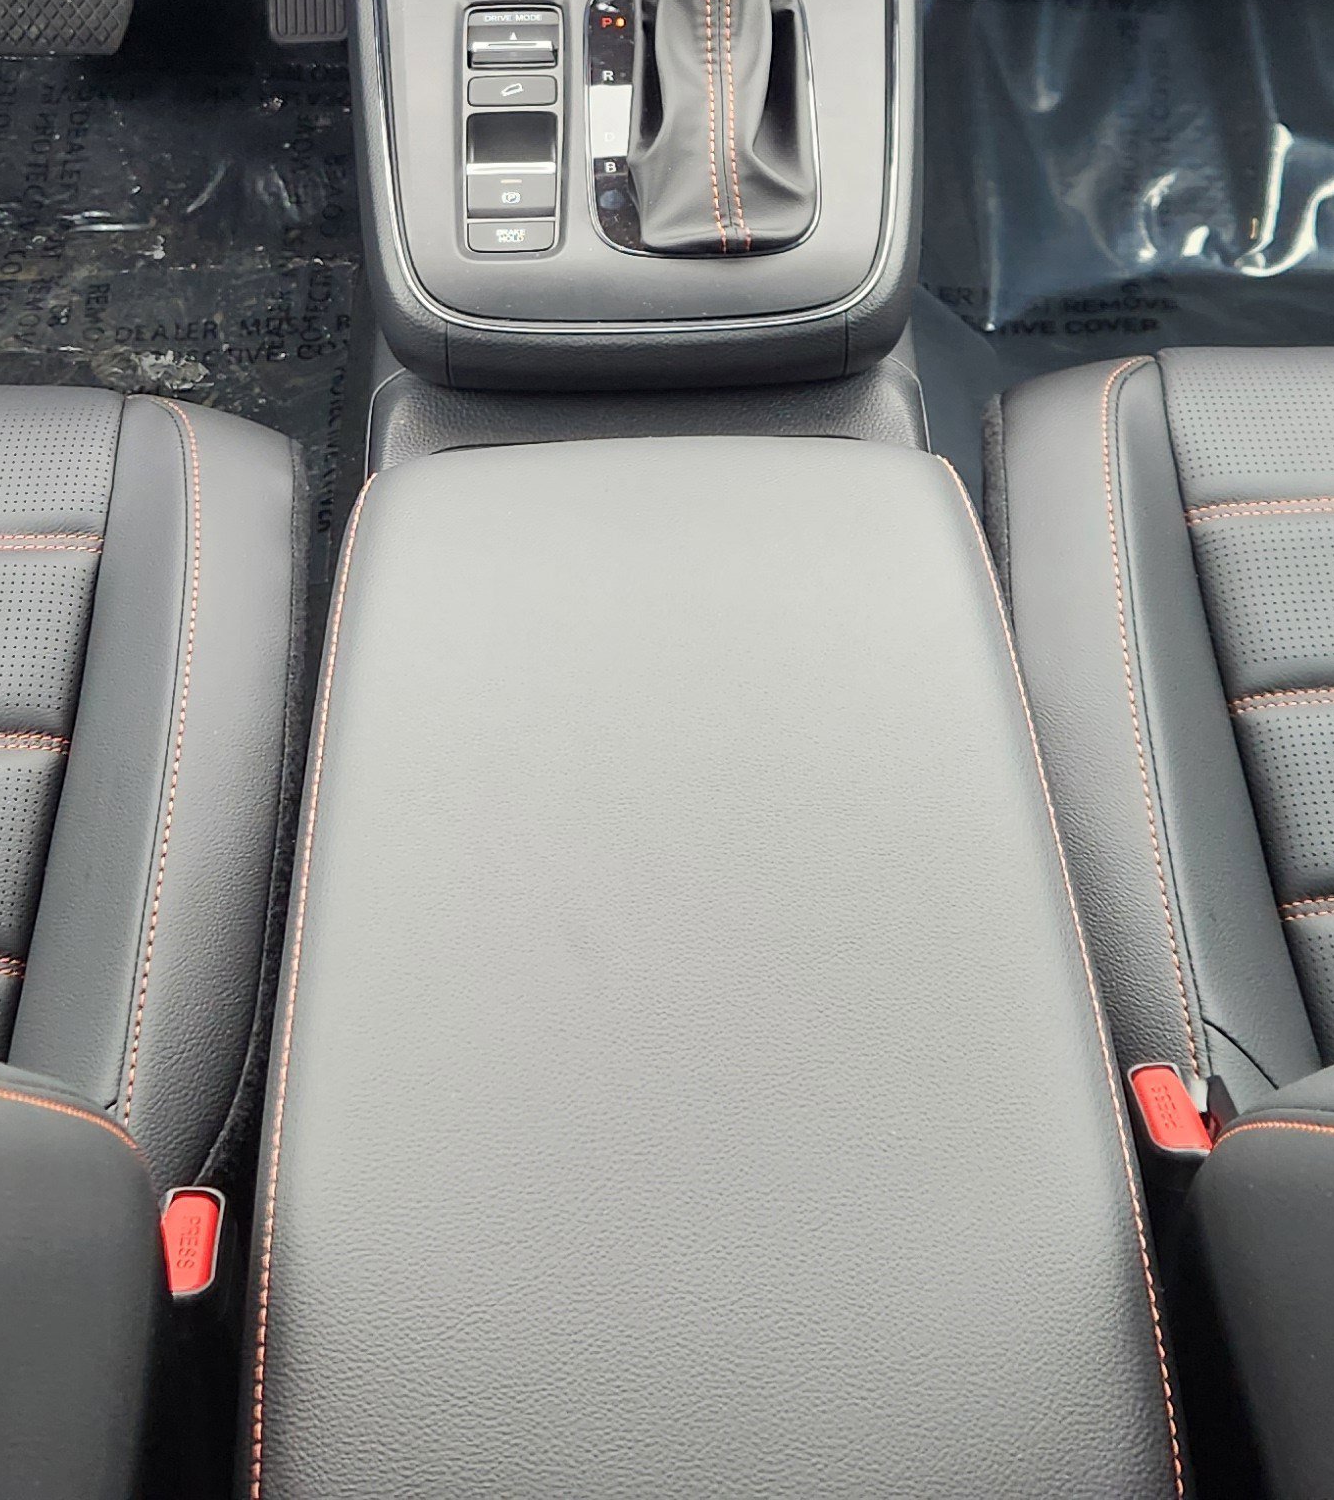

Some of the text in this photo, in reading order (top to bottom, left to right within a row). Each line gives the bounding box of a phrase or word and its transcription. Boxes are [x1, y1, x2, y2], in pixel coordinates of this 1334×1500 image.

[484, 14, 543, 22] DRIVE MODE
[602, 18, 613, 27] P
[603, 70, 614, 82] R
[605, 162, 617, 174] B
[495, 229, 526, 237] BRAKE
